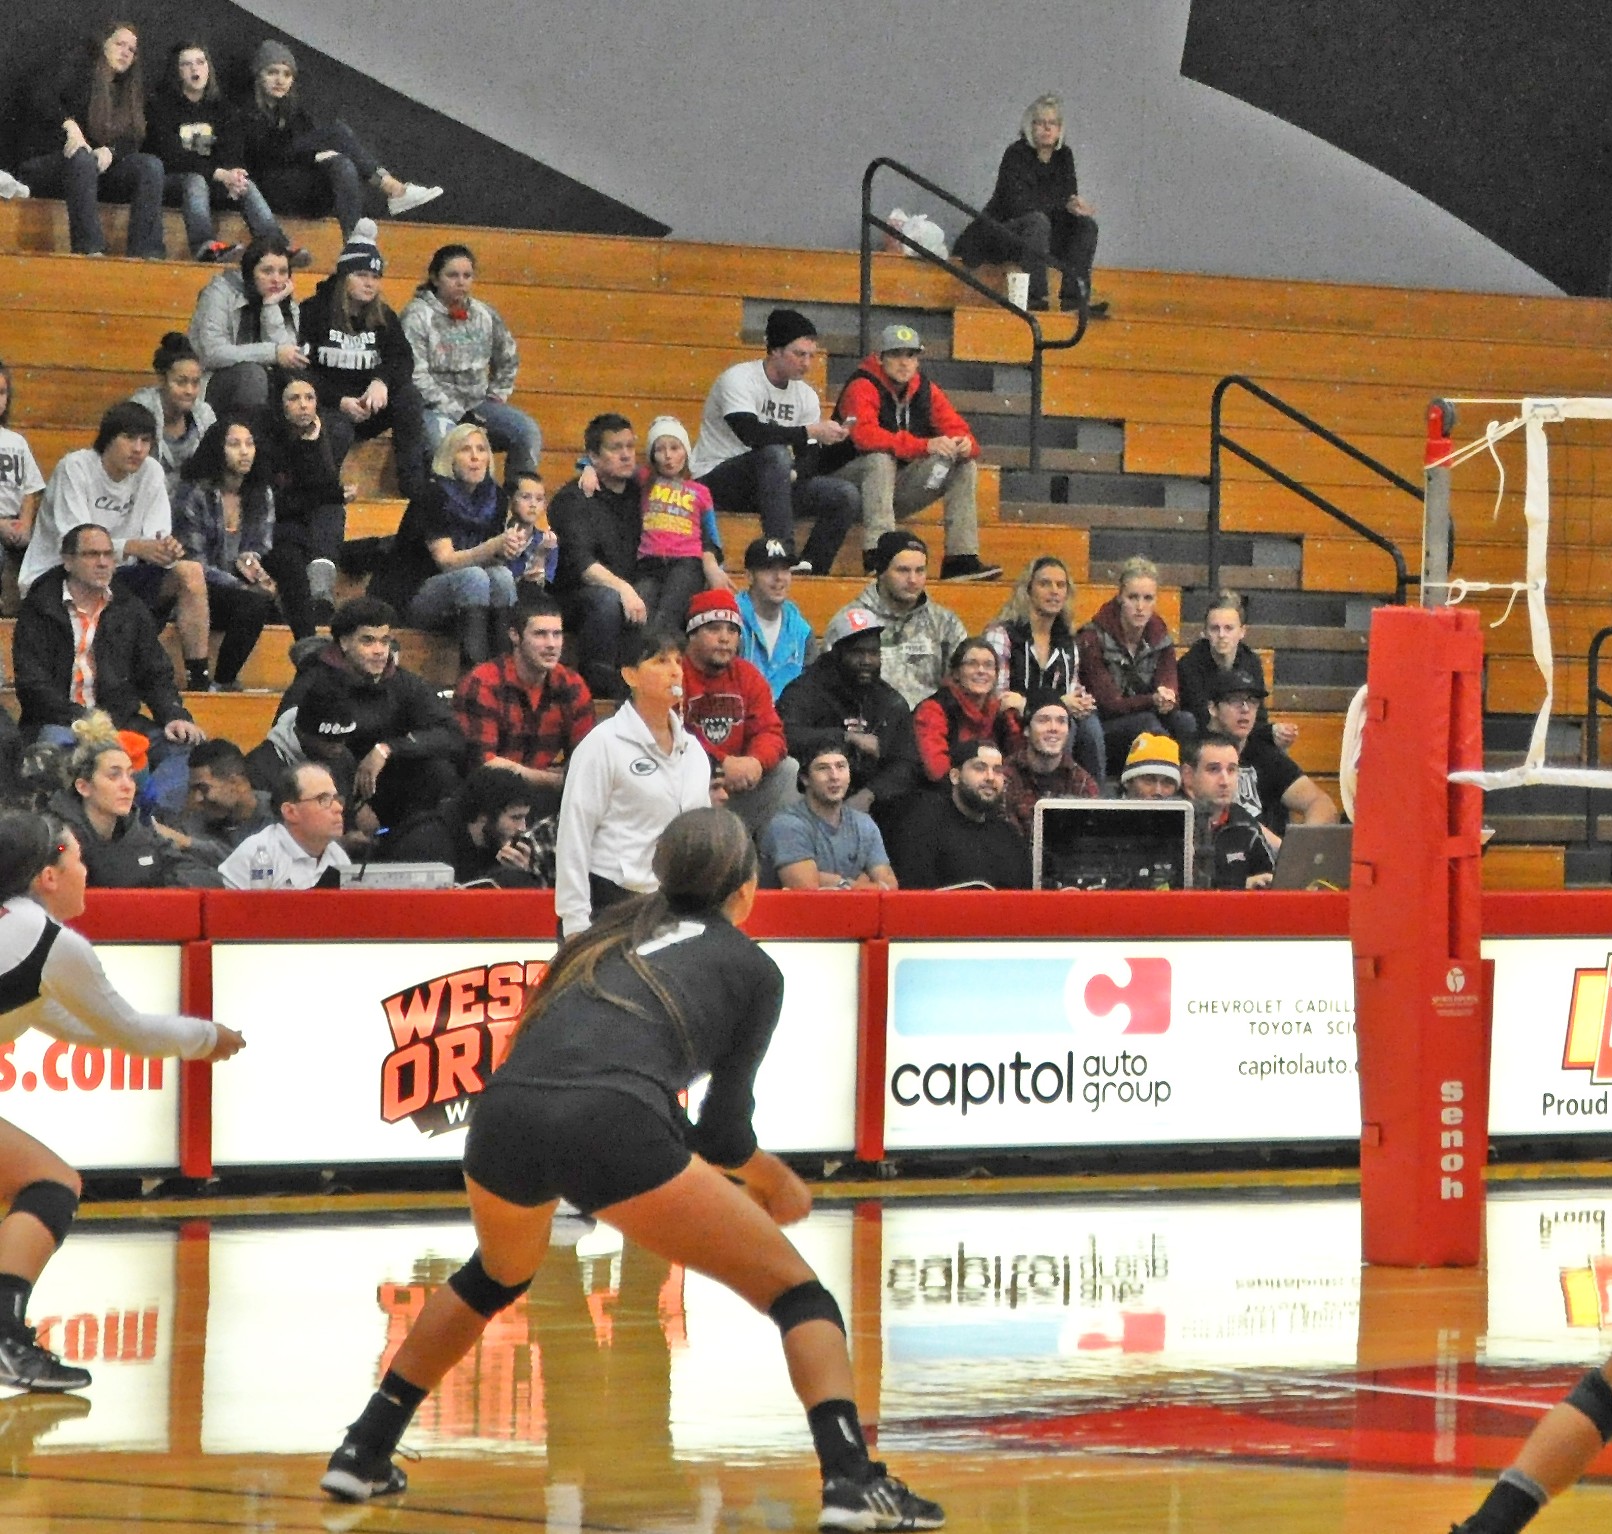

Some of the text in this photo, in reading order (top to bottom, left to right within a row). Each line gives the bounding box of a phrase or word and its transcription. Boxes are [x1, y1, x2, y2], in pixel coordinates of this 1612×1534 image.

[1187, 999, 1357, 1014] CHEVROLET CADILL
[1249, 1020, 1313, 1036] TOYOTA
[1082, 1050, 1148, 1078] auto
[890, 1050, 1074, 1116] capitol
[1082, 1078, 1172, 1113] group
[1542, 1091, 1609, 1117] Proud
